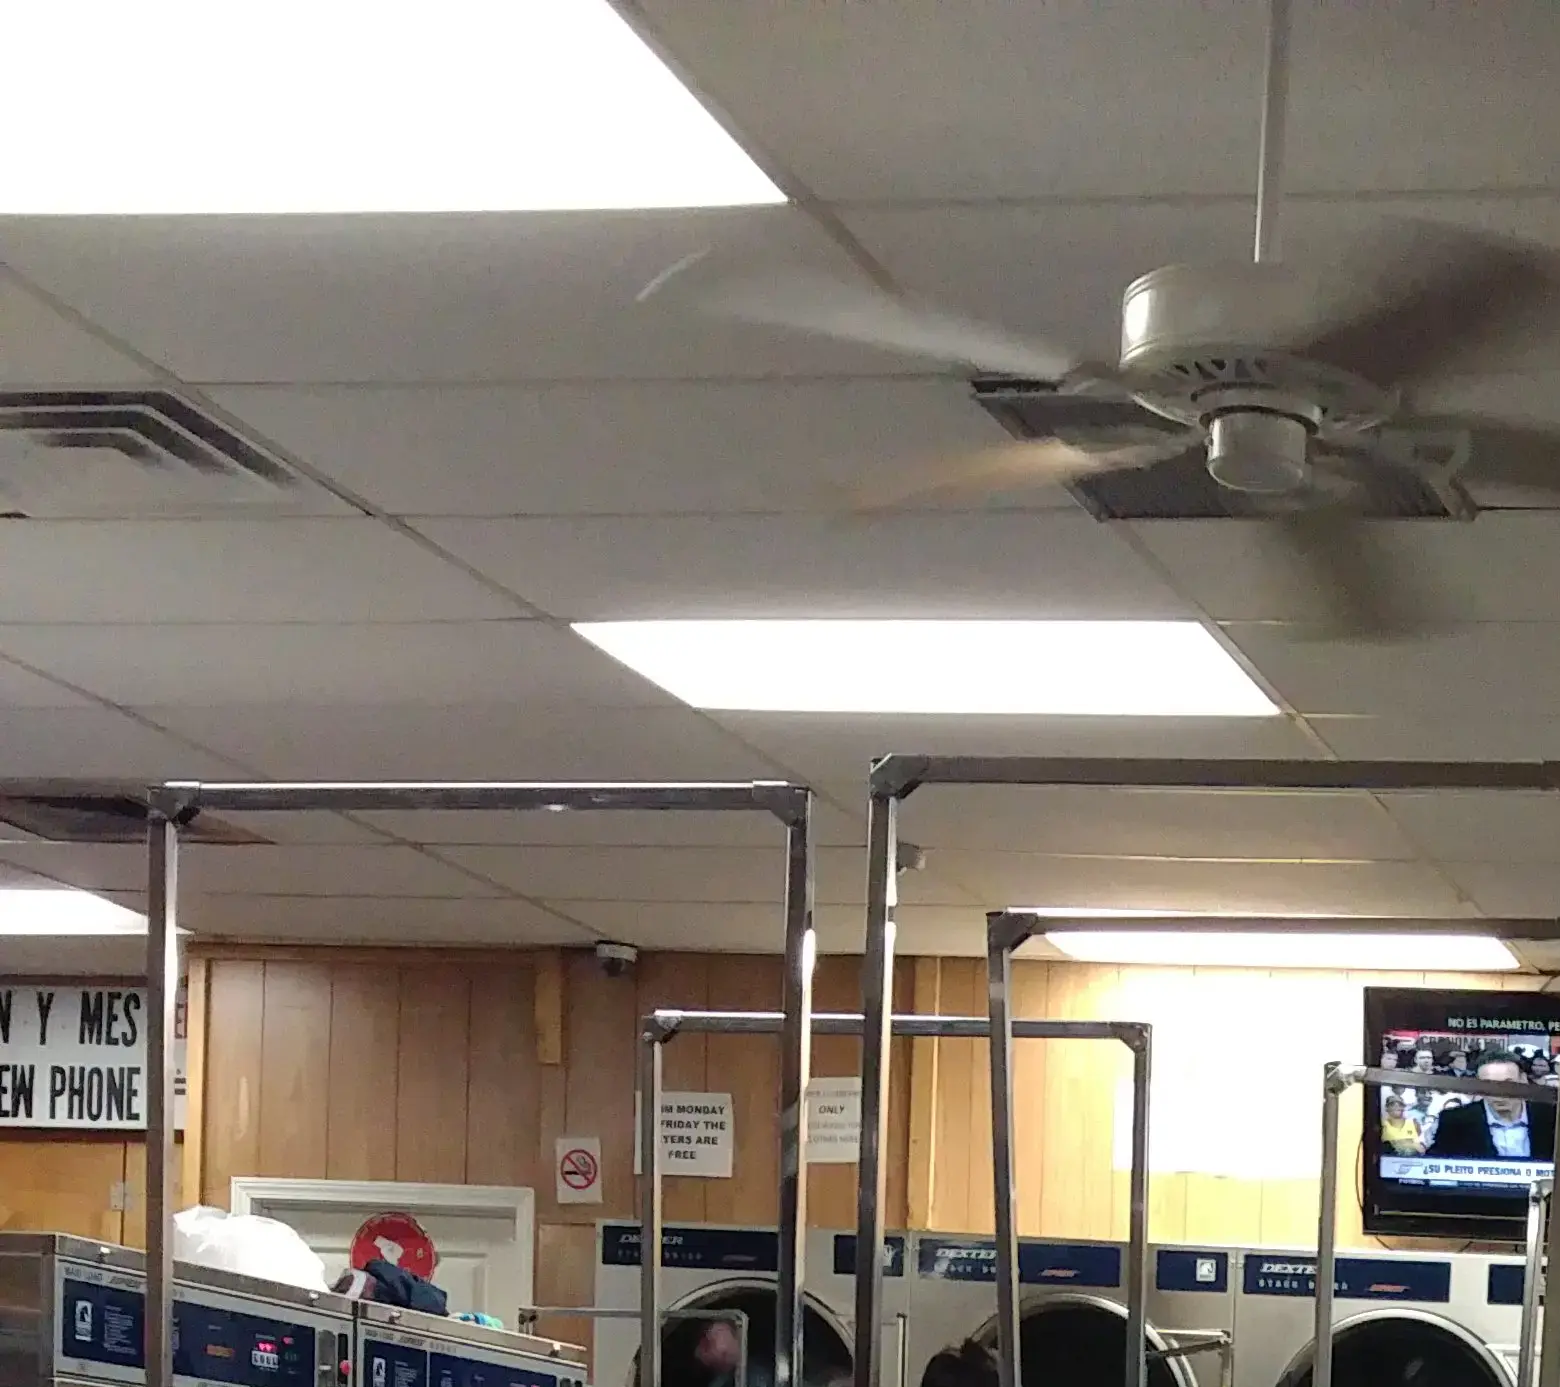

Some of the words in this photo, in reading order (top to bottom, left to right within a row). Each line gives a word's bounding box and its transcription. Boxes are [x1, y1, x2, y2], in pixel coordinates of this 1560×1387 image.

[37, 991, 54, 1045] Y
[79, 991, 141, 1047] MES
[1448, 1018, 1463, 1028] NO
[1466, 1018, 1478, 1029] ES
[0, 1064, 35, 1118] EW
[50, 1065, 141, 1121] PHONE
[676, 1105, 725, 1115] MONDAY
[818, 1103, 845, 1114] ONLY
[702, 1121, 726, 1131] THE
[696, 1136, 718, 1146] ARE
[668, 1150, 697, 1160] FREE
[619, 1234, 683, 1245] DEER
